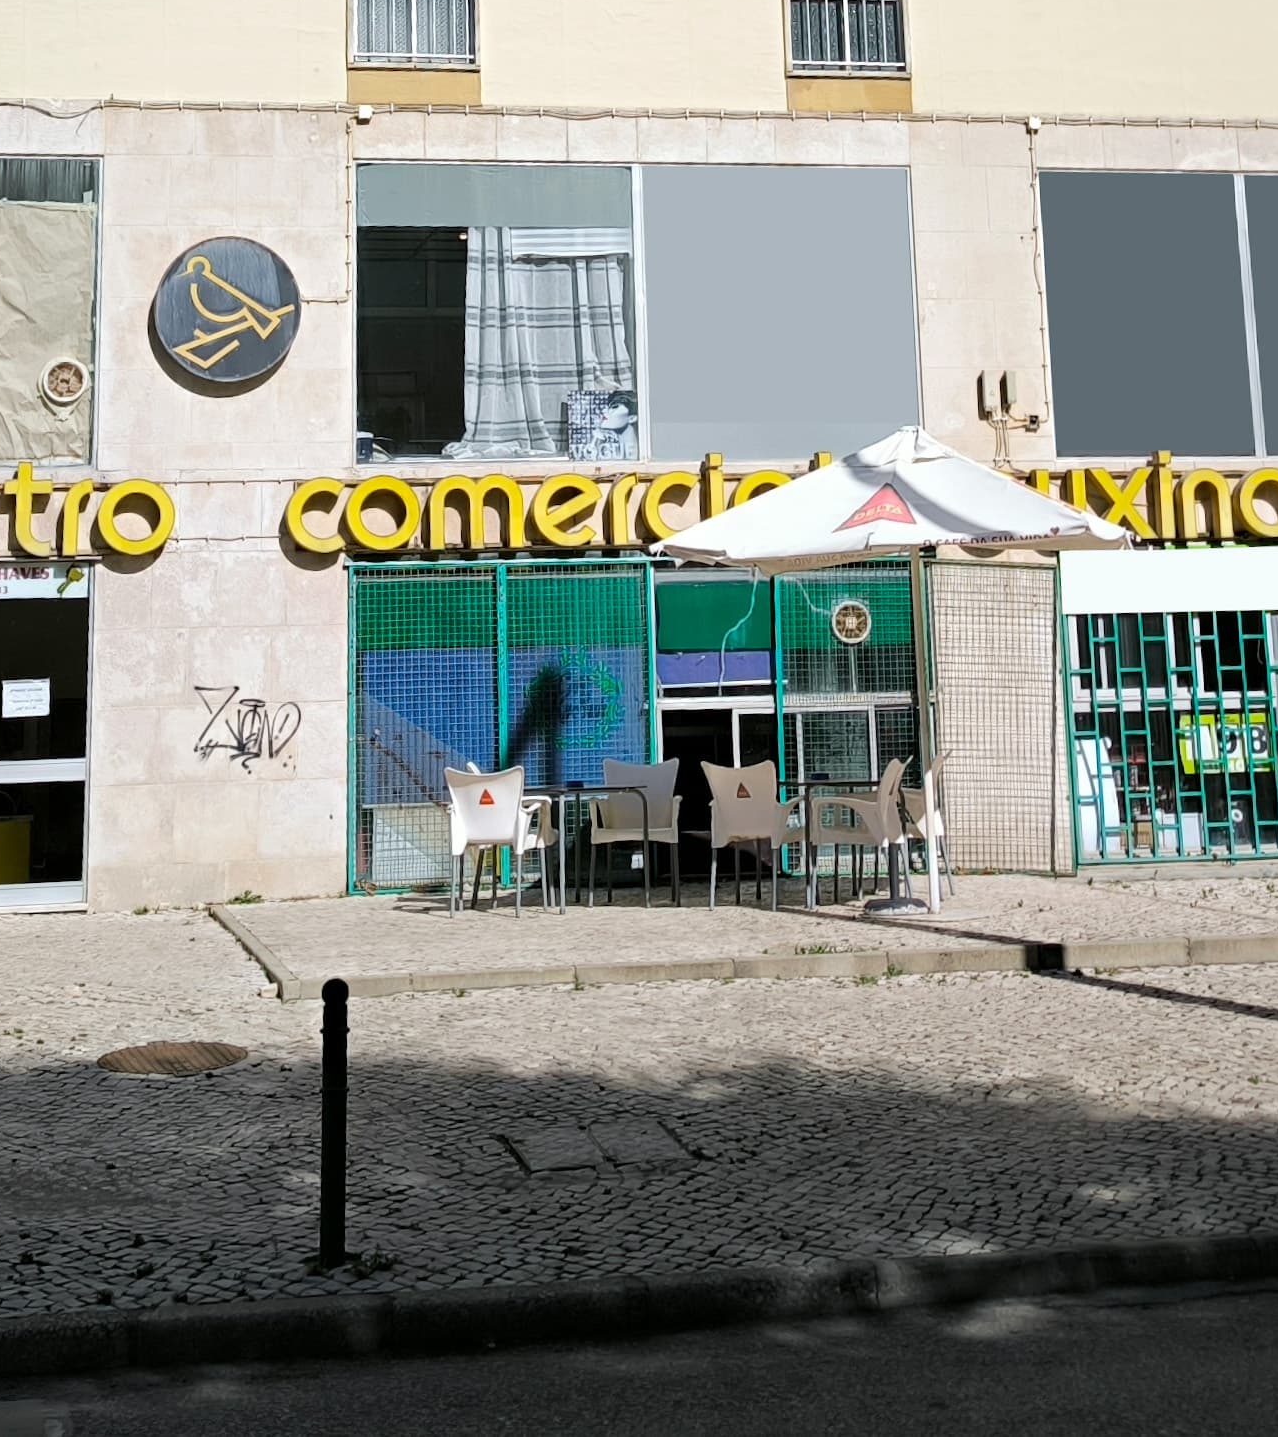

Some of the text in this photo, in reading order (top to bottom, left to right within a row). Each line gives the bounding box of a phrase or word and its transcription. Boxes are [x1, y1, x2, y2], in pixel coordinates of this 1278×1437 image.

[569, 443, 638, 460] VOGUE
[285, 451, 833, 554] comerci
[852, 503, 903, 522] DELTA
